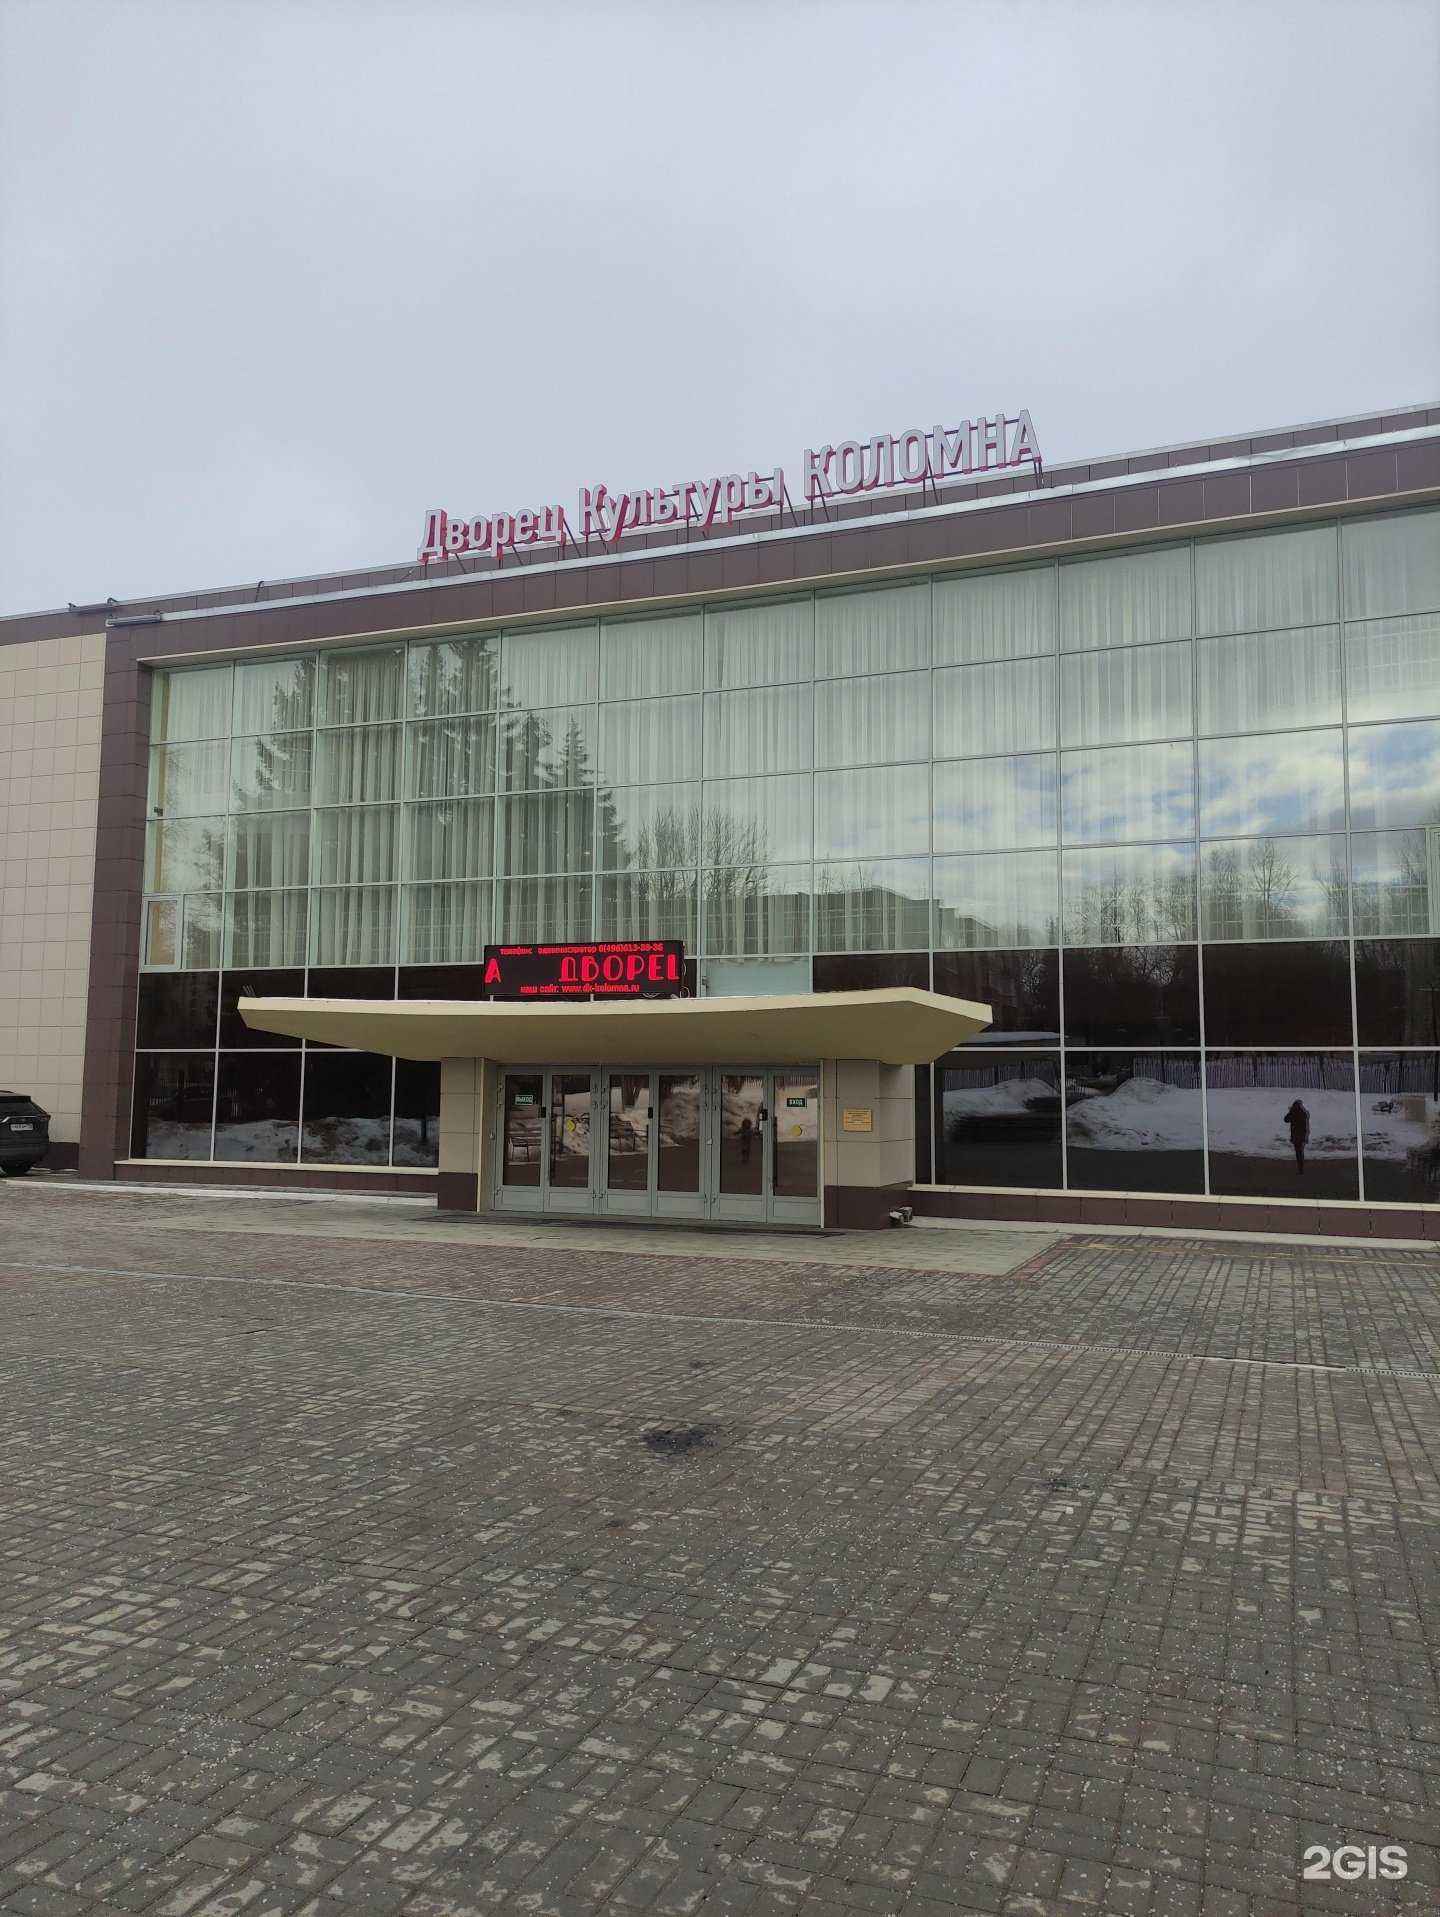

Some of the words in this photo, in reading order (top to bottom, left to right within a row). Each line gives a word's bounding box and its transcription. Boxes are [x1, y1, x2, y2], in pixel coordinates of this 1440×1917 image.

[417, 503, 566, 566] Дворец
[578, 467, 785, 544] Культуры
[804, 407, 1043, 501] КОЛОМНА
